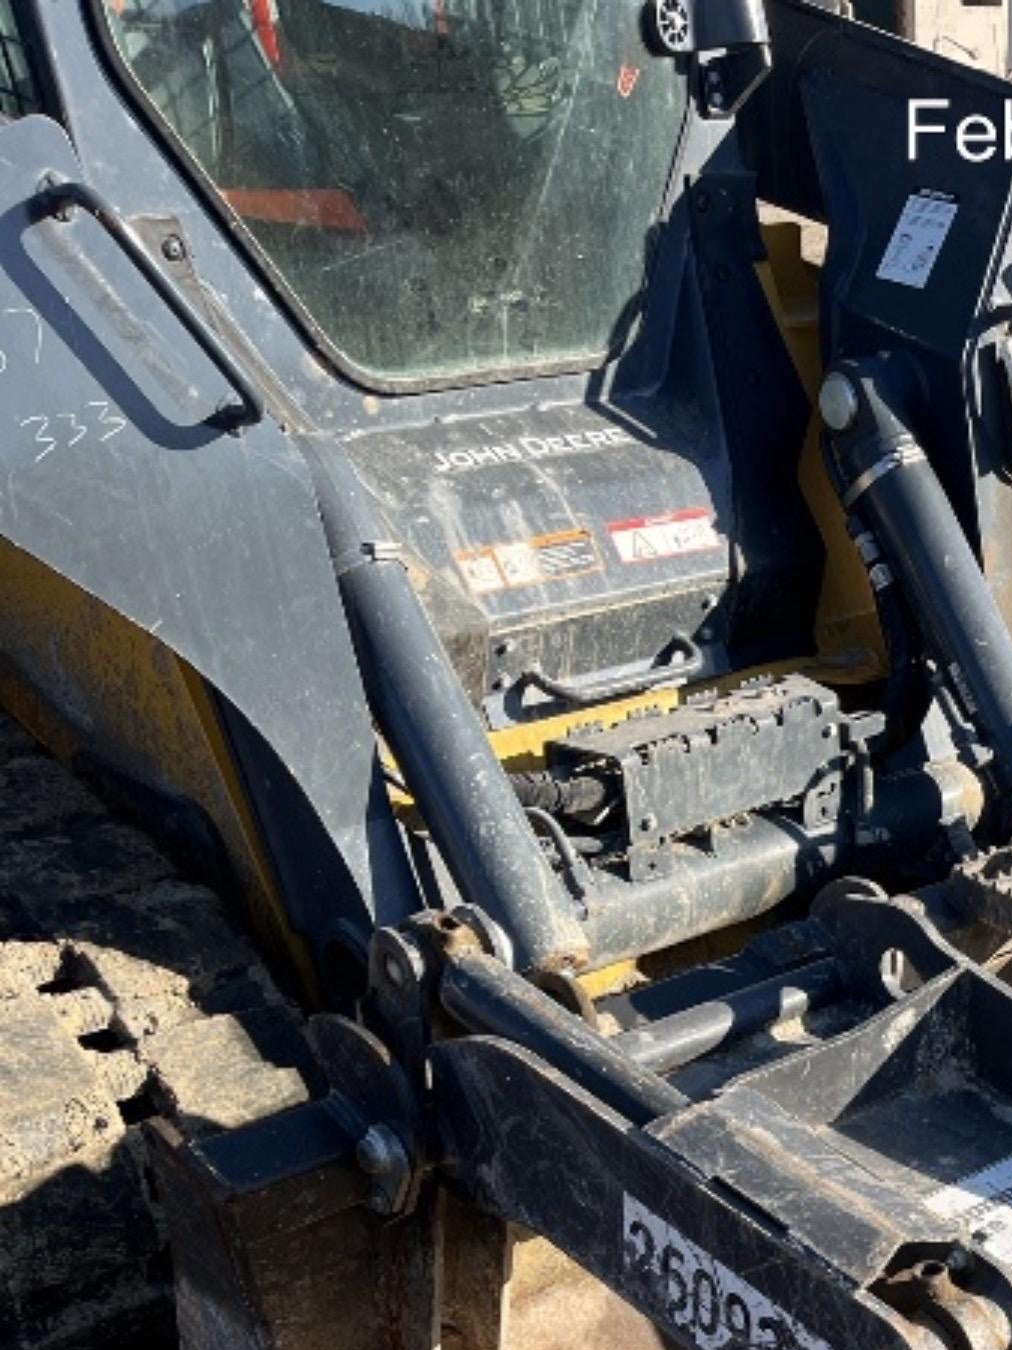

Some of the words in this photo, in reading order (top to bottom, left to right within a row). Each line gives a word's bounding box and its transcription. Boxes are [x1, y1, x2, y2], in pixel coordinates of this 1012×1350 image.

[19, 401, 127, 463] 333
[434, 444, 523, 473] JOHN
[518, 428, 633, 460] DEERE
